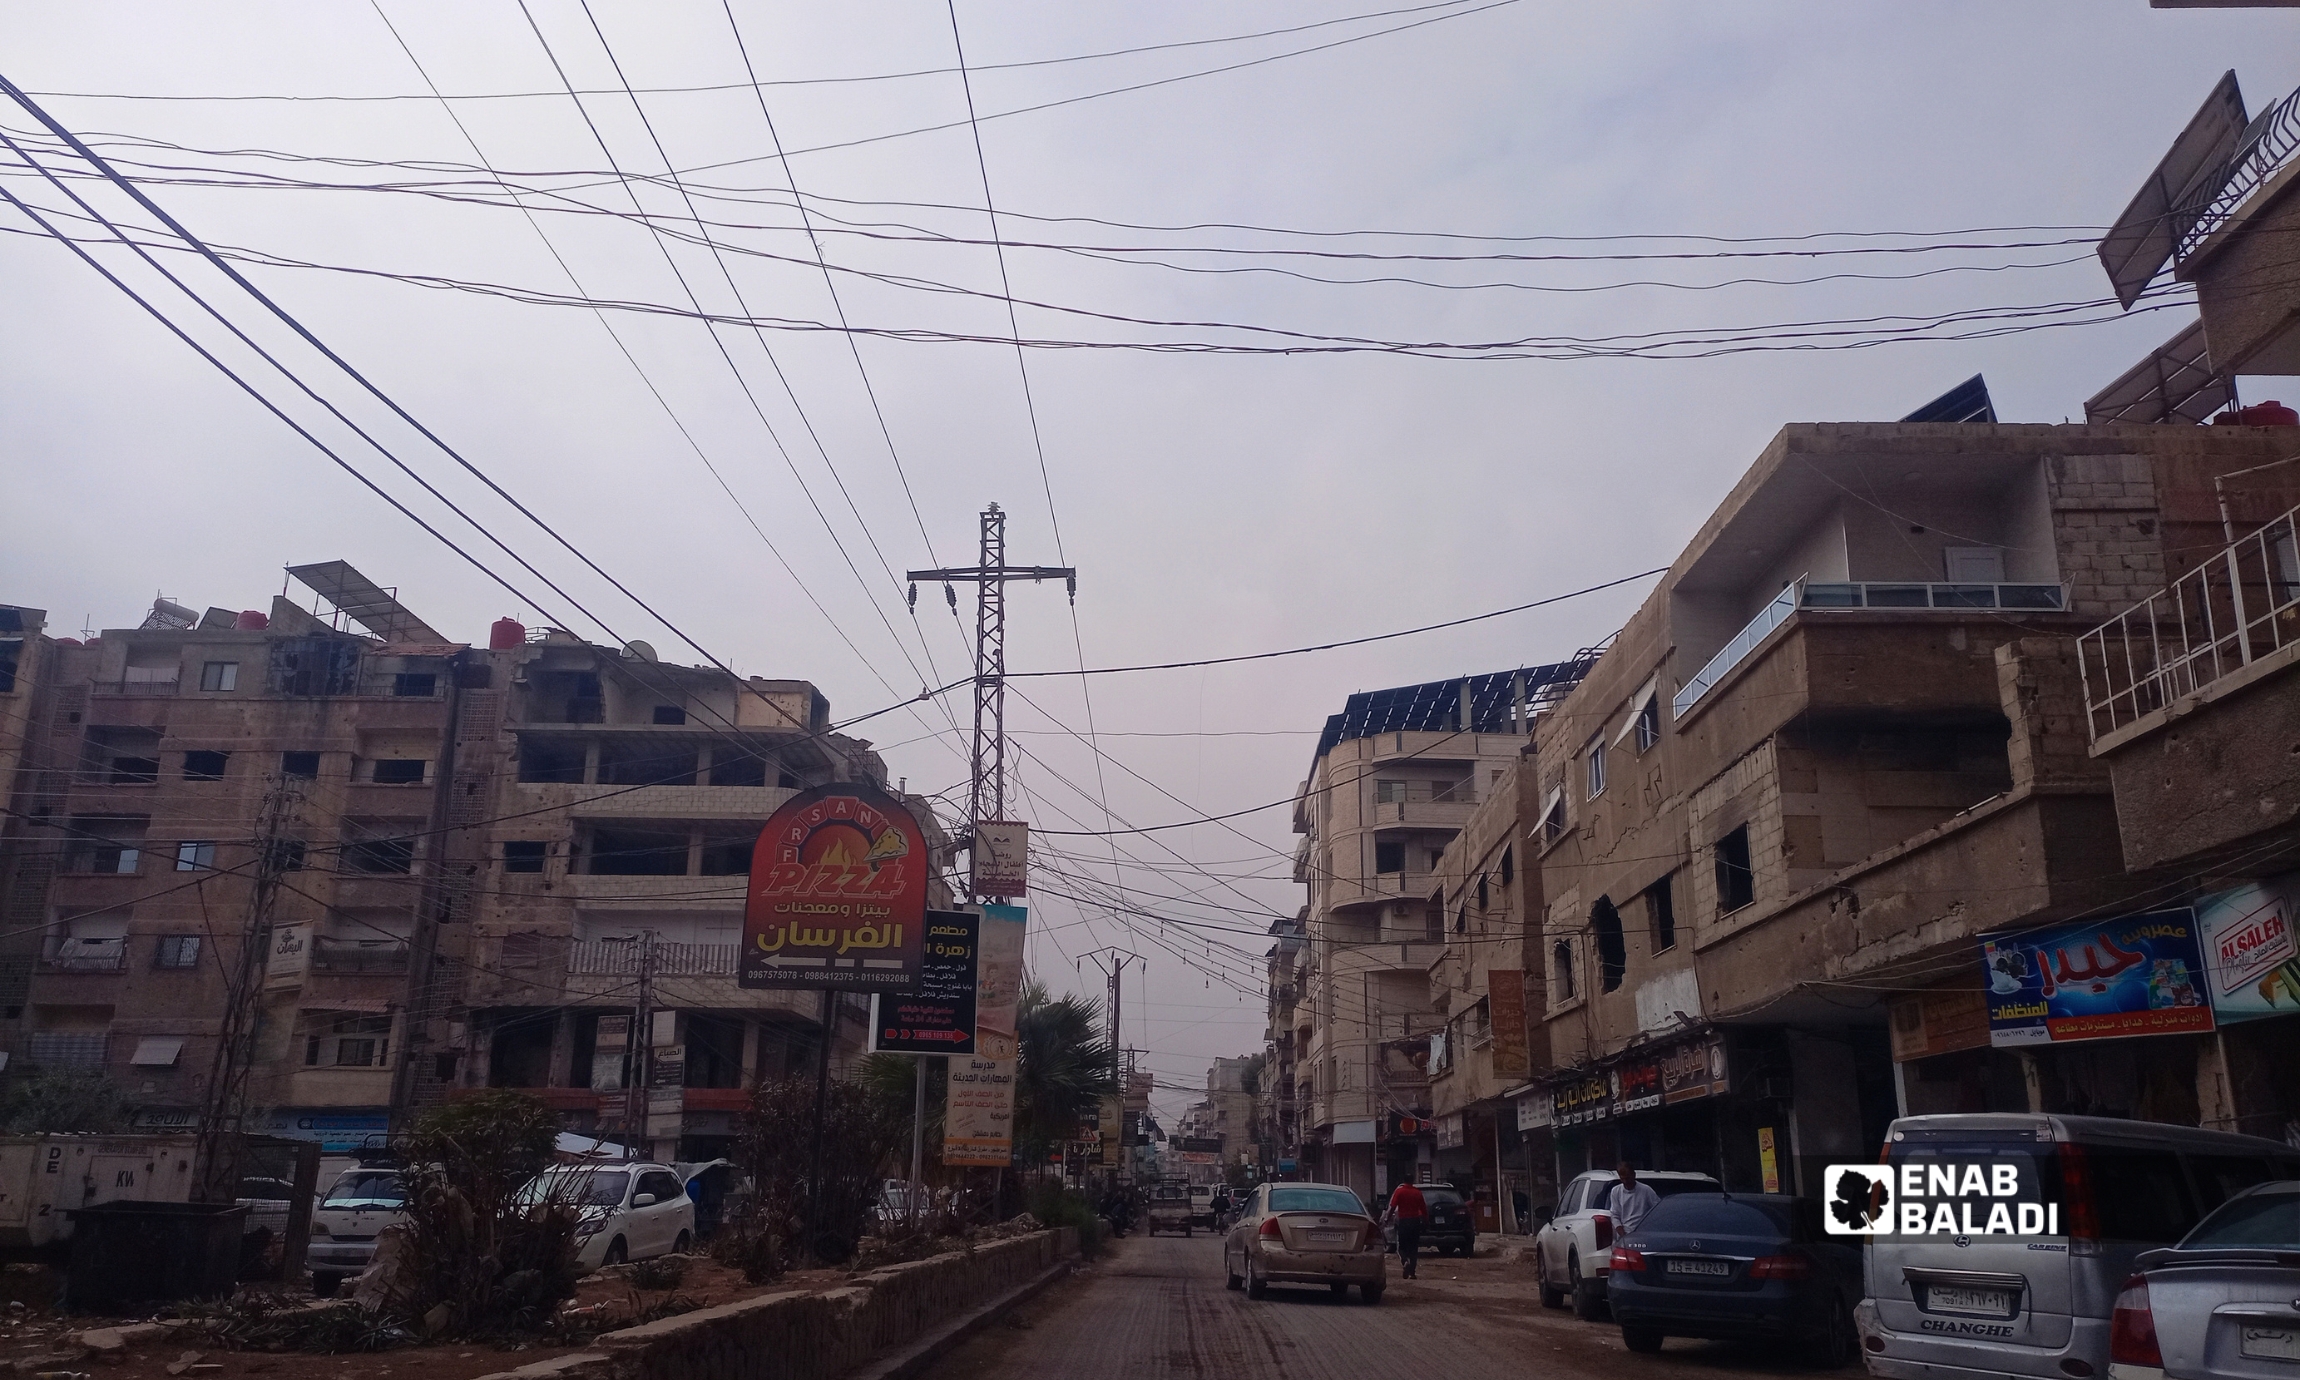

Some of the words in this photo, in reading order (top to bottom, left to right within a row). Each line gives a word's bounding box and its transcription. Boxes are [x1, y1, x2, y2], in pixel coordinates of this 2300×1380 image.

[761, 862, 908, 900] PIZZA
[774, 901, 851, 917] ومعجنات
[757, 920, 903, 955] الفرسان
[929, 925, 968, 936] مطعم
[935, 942, 971, 959] زهرة
[748, 970, 797, 980] 0967575078
[804, 971, 854, 981] 0988412375
[861, 973, 910, 983] 0116292088
[1992, 1001, 2049, 1021] للمنظفات
[971, 1060, 996, 1070] مدرسة
[953, 1072, 979, 1082] الحديثة
[980, 1074, 1012, 1084] المهارات
[1671, 1261, 1683, 1270] 15
[1695, 1262, 1725, 1273] 41249
[1920, 1320, 2014, 1337] CHANGHE
